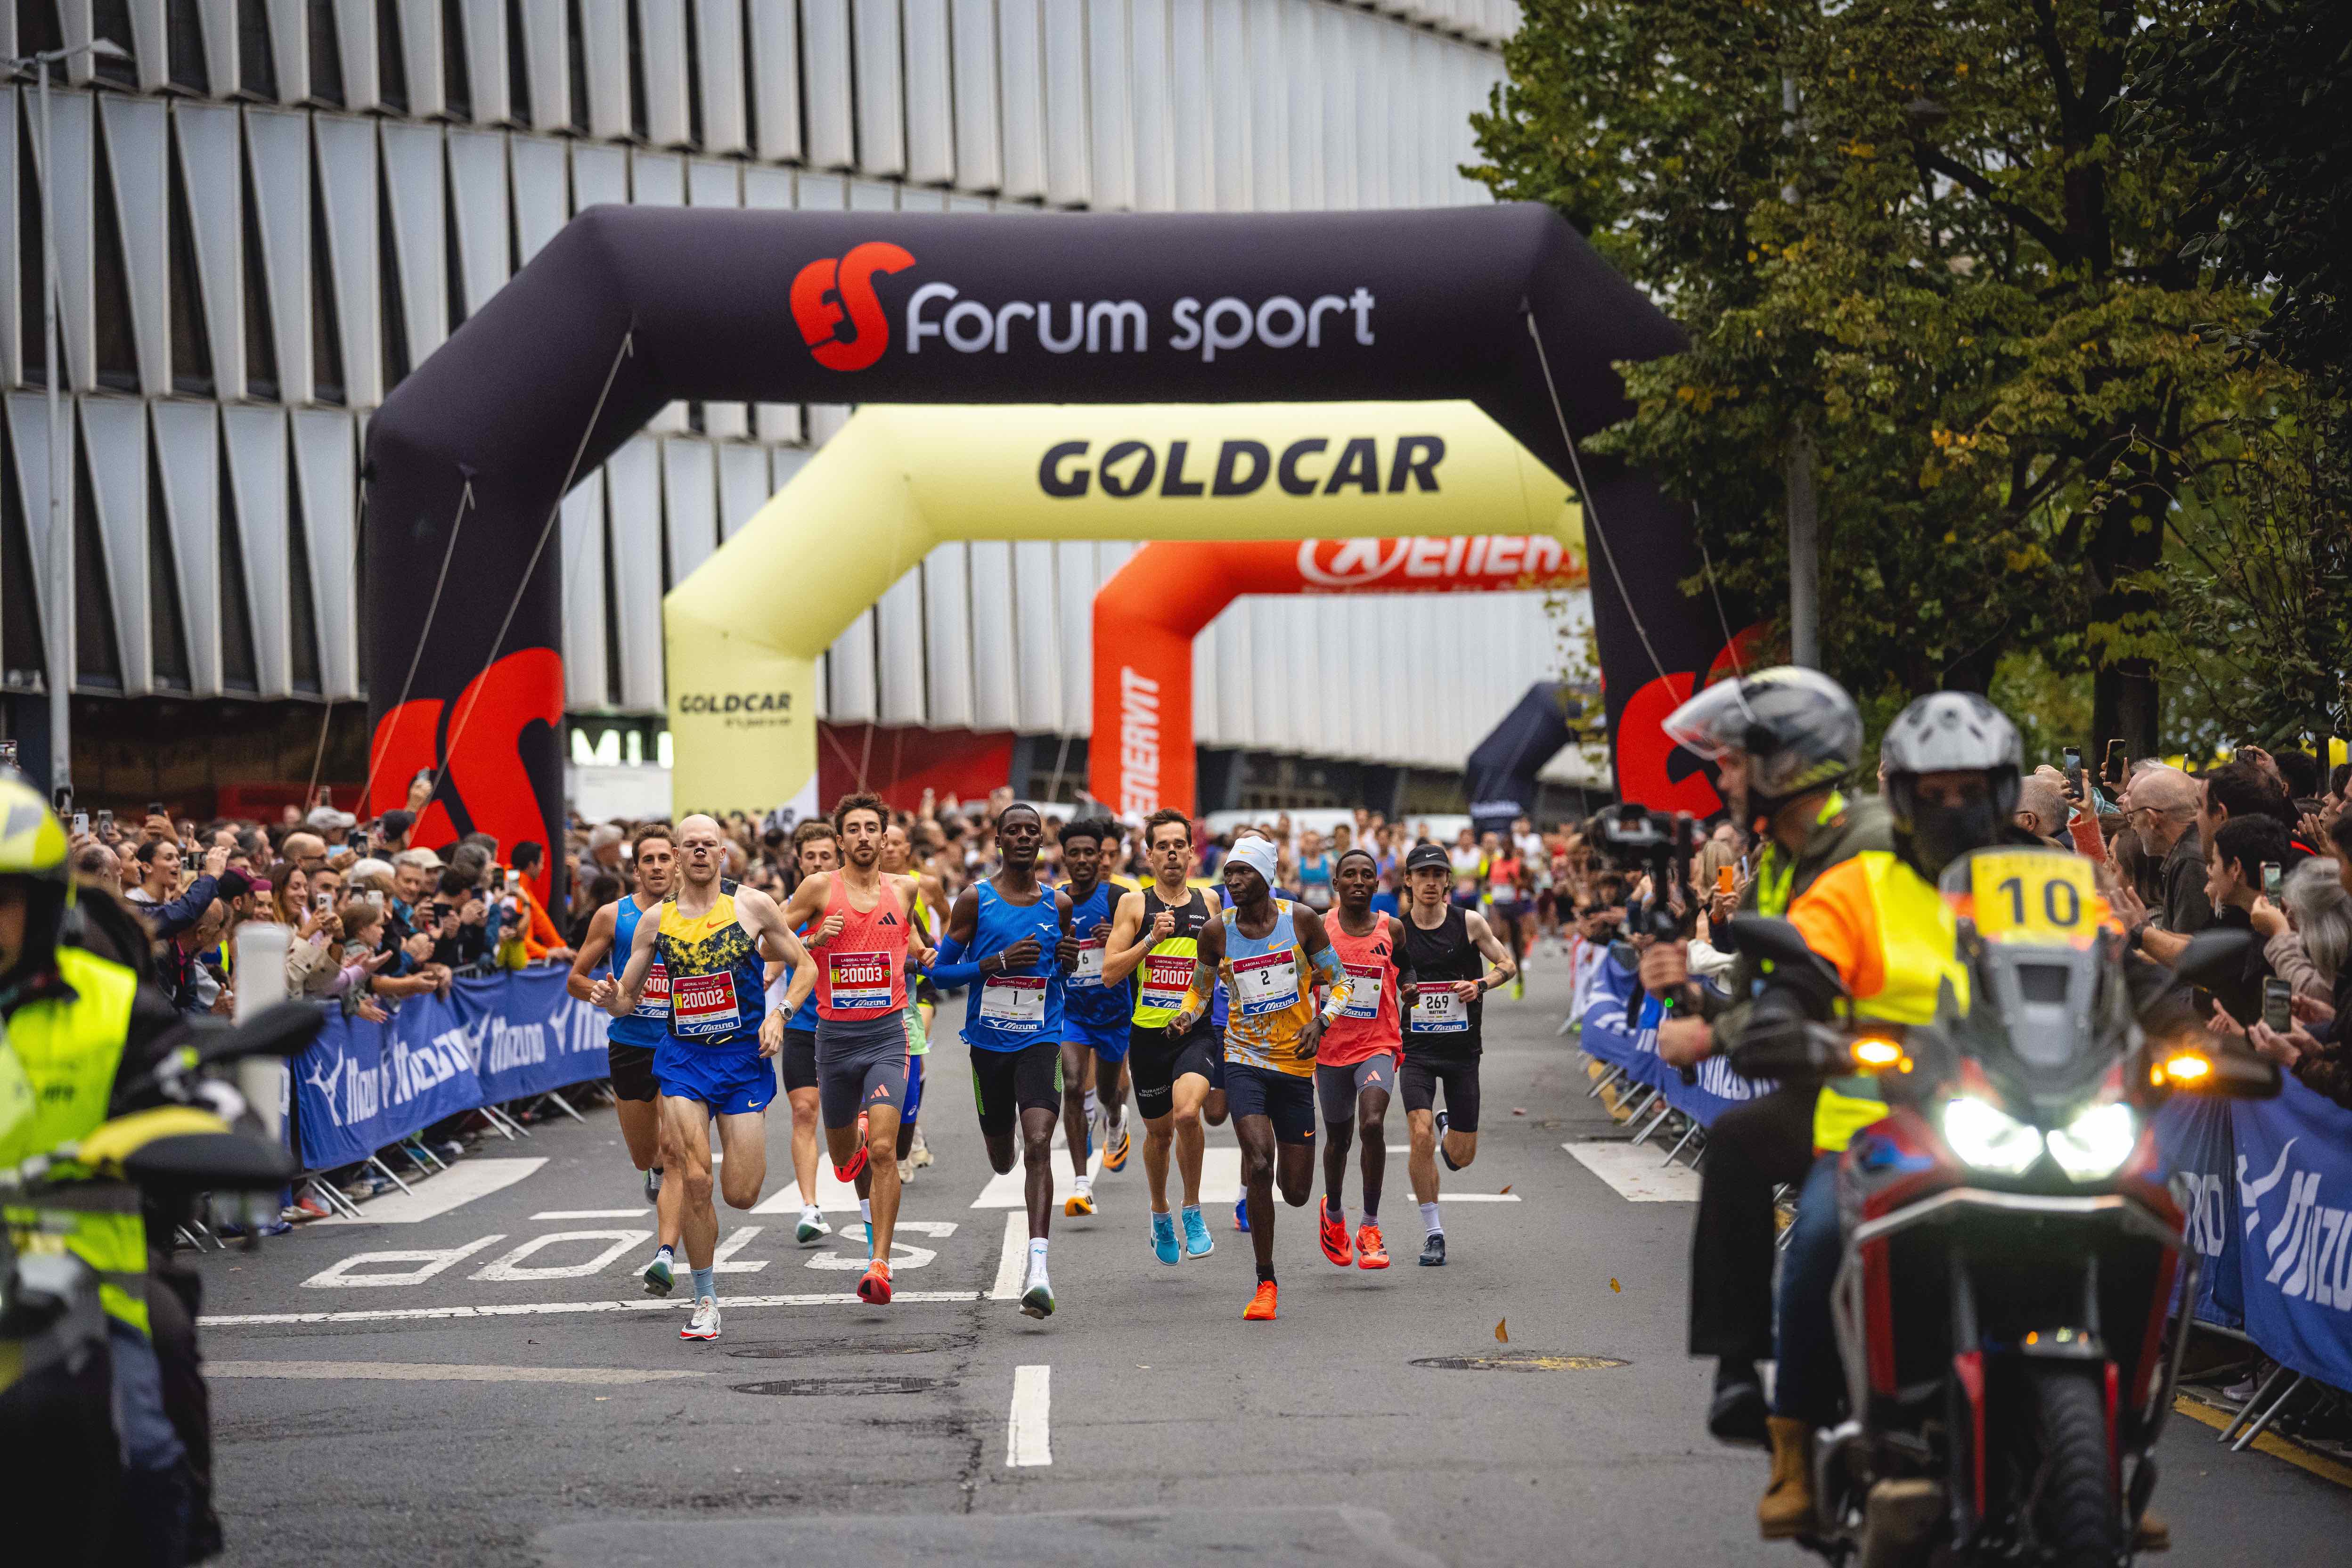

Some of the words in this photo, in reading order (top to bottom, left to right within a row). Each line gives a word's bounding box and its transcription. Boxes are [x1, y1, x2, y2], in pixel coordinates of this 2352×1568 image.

[1169, 288, 1375, 362] sport
[1038, 435, 1446, 498] GOLDCAR
[679, 693, 792, 713] GOLDCAR
[1999, 877, 2081, 927] 10
[1083, 953, 1089, 964] 6
[840, 967, 882, 983] 20003
[1152, 969, 1194, 986] 20007
[1260, 970, 1270, 985] 2
[682, 989, 726, 1008] 20002
[1013, 991, 1018, 1005] 1
[1426, 996, 1449, 1009] 269
